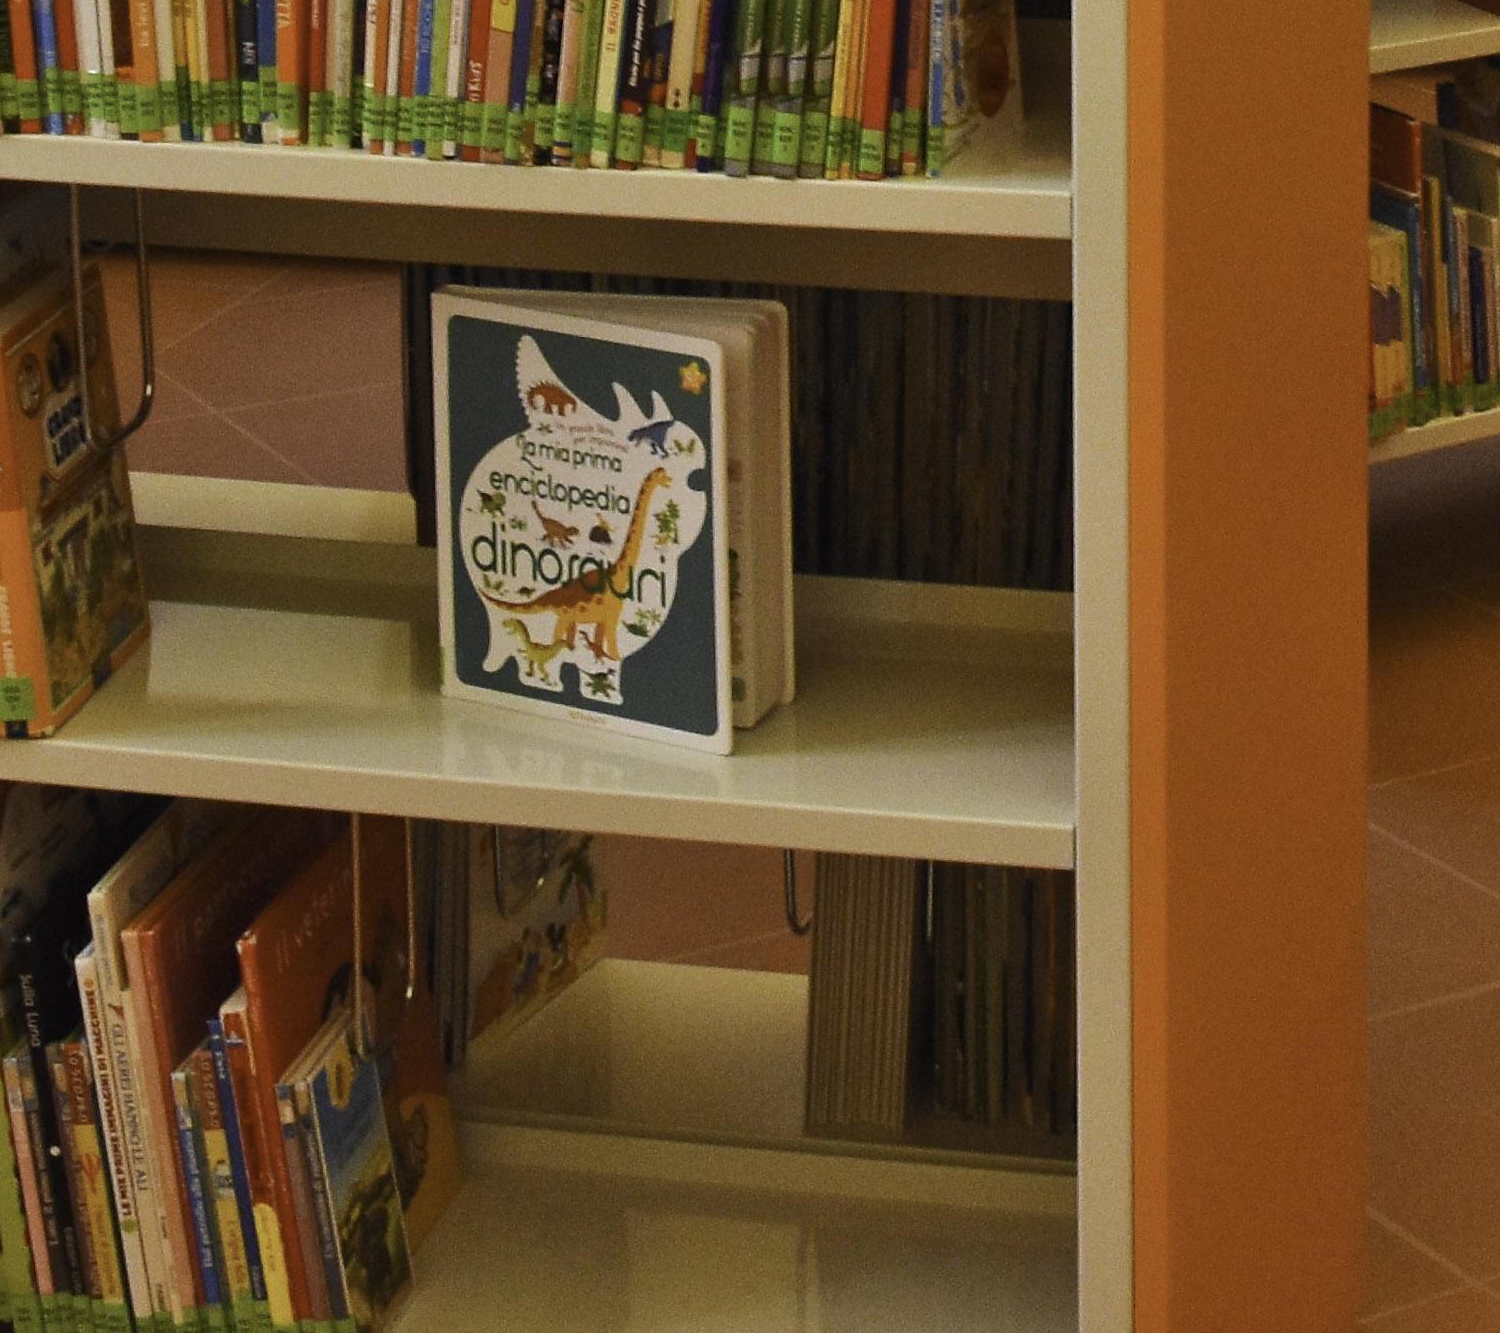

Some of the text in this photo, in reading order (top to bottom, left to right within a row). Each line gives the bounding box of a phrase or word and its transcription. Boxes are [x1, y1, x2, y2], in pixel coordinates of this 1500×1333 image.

[538, 440, 569, 462] mia
[573, 445, 623, 473] prima
[489, 467, 631, 525] enciclopedia
[471, 521, 669, 609] dinosauri
[19, 974, 42, 1047] Sulla Luna
